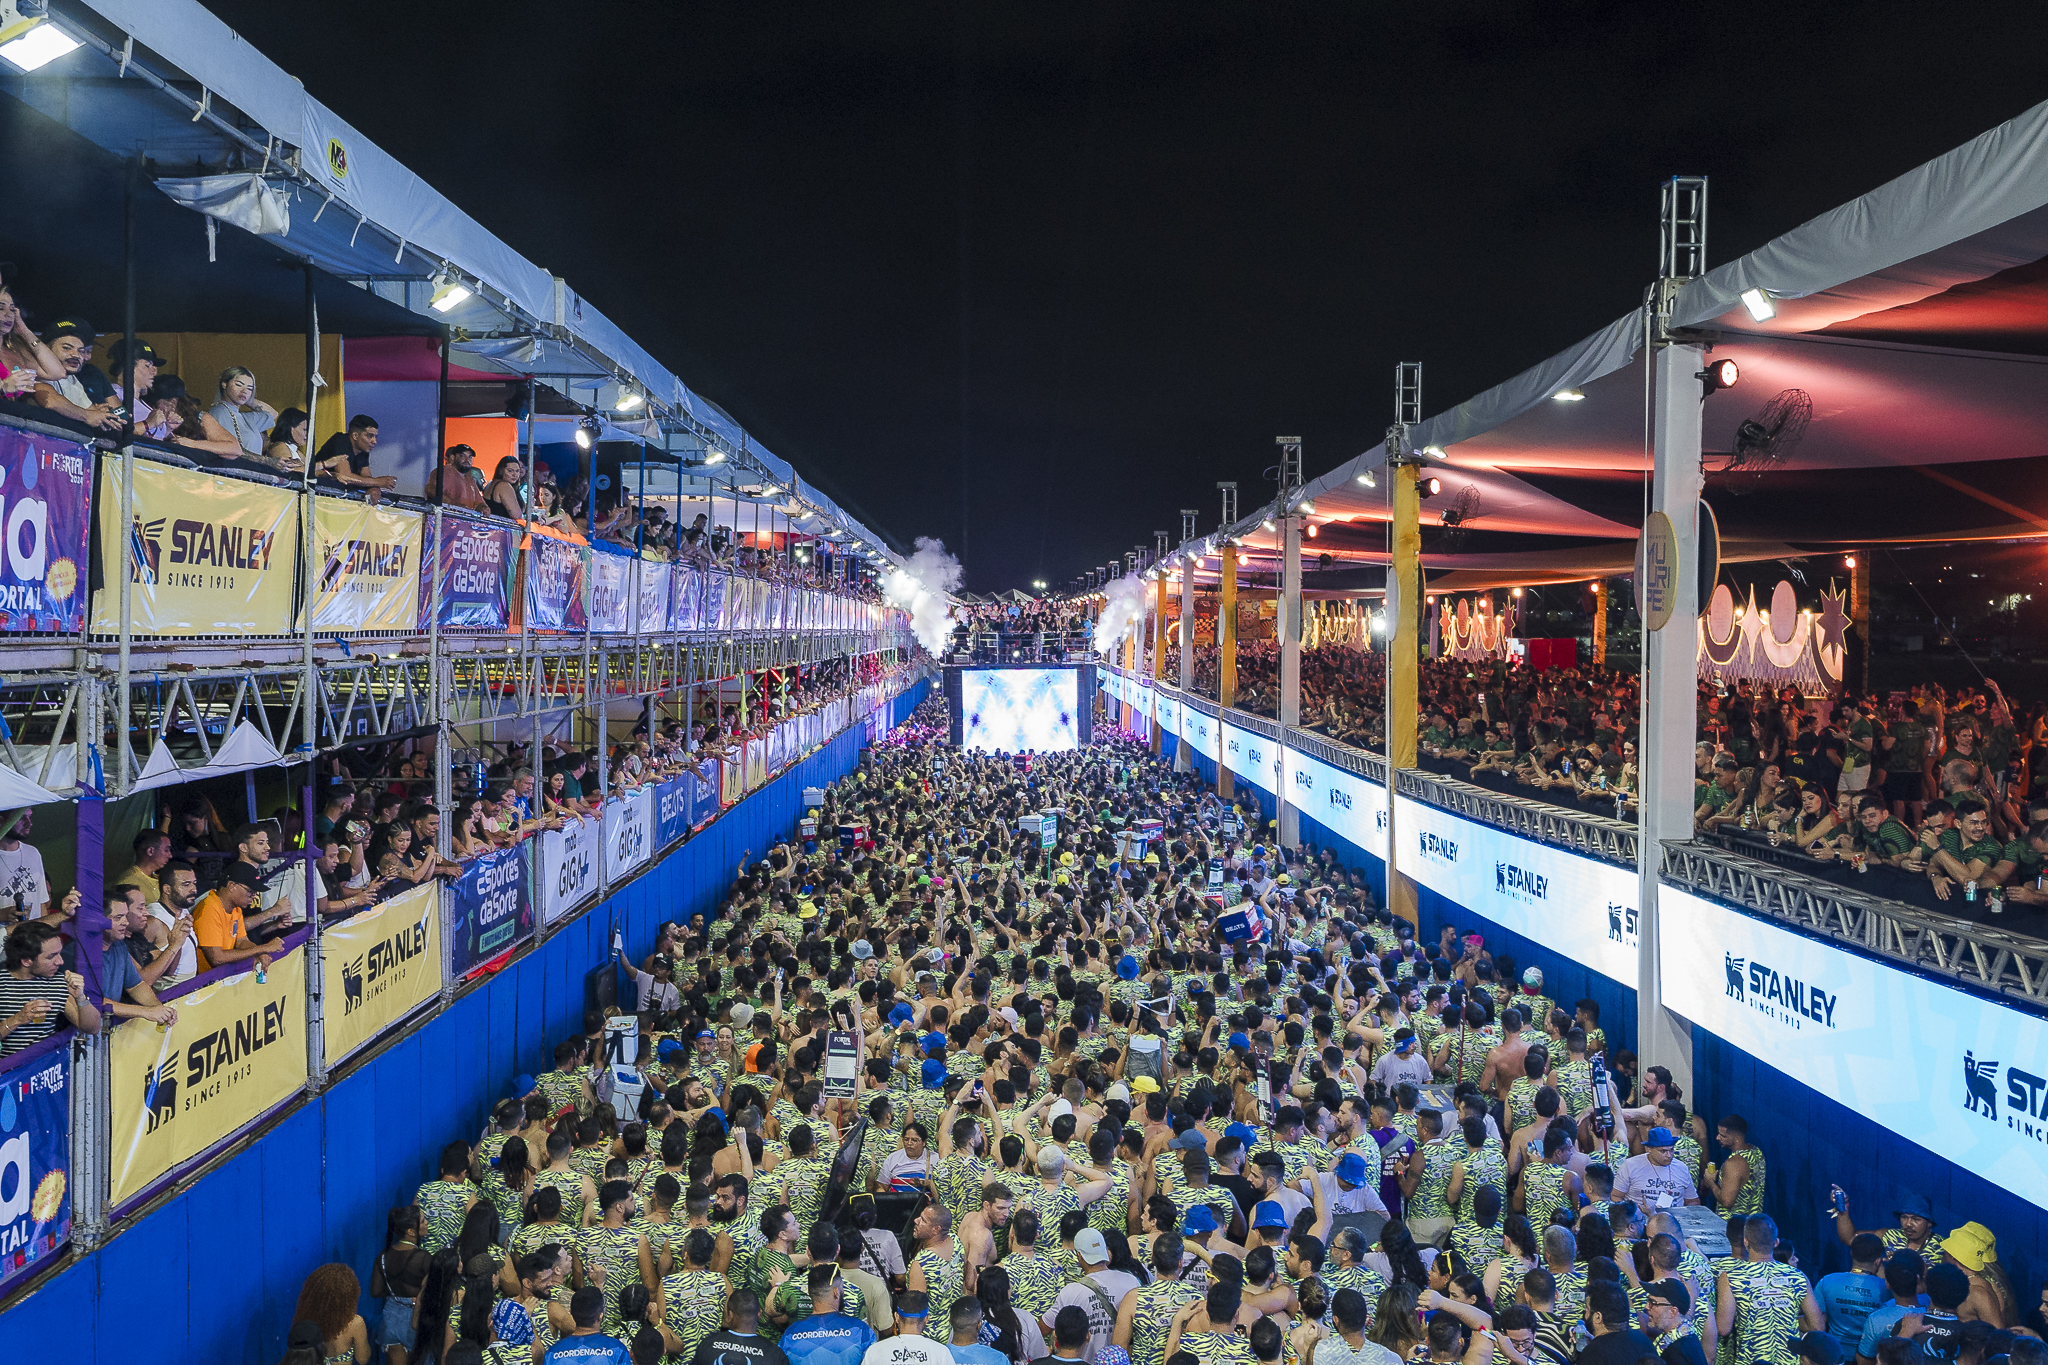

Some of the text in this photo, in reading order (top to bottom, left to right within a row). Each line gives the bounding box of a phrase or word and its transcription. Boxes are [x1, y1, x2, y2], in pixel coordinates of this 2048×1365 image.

[170, 518, 275, 571] STANLEY
[345, 539, 409, 578] STANLEY
[168, 572, 234, 590] SINCE 1913
[661, 786, 685, 824] BEATS
[1428, 832, 1459, 863] STANLEY
[476, 857, 519, 897] Esportes
[1507, 864, 1549, 900] STANLEY
[366, 916, 429, 984] STANLEY
[366, 969, 407, 1002] SINCE 1913
[1749, 961, 1837, 1028] STANLEY
[186, 995, 287, 1089] STANLEY
[185, 1063, 252, 1111] SINCE 1913
[553, 1346, 614, 1360] COORDENAÇÃO
[792, 1327, 852, 1341] COORDENAÇÃO
